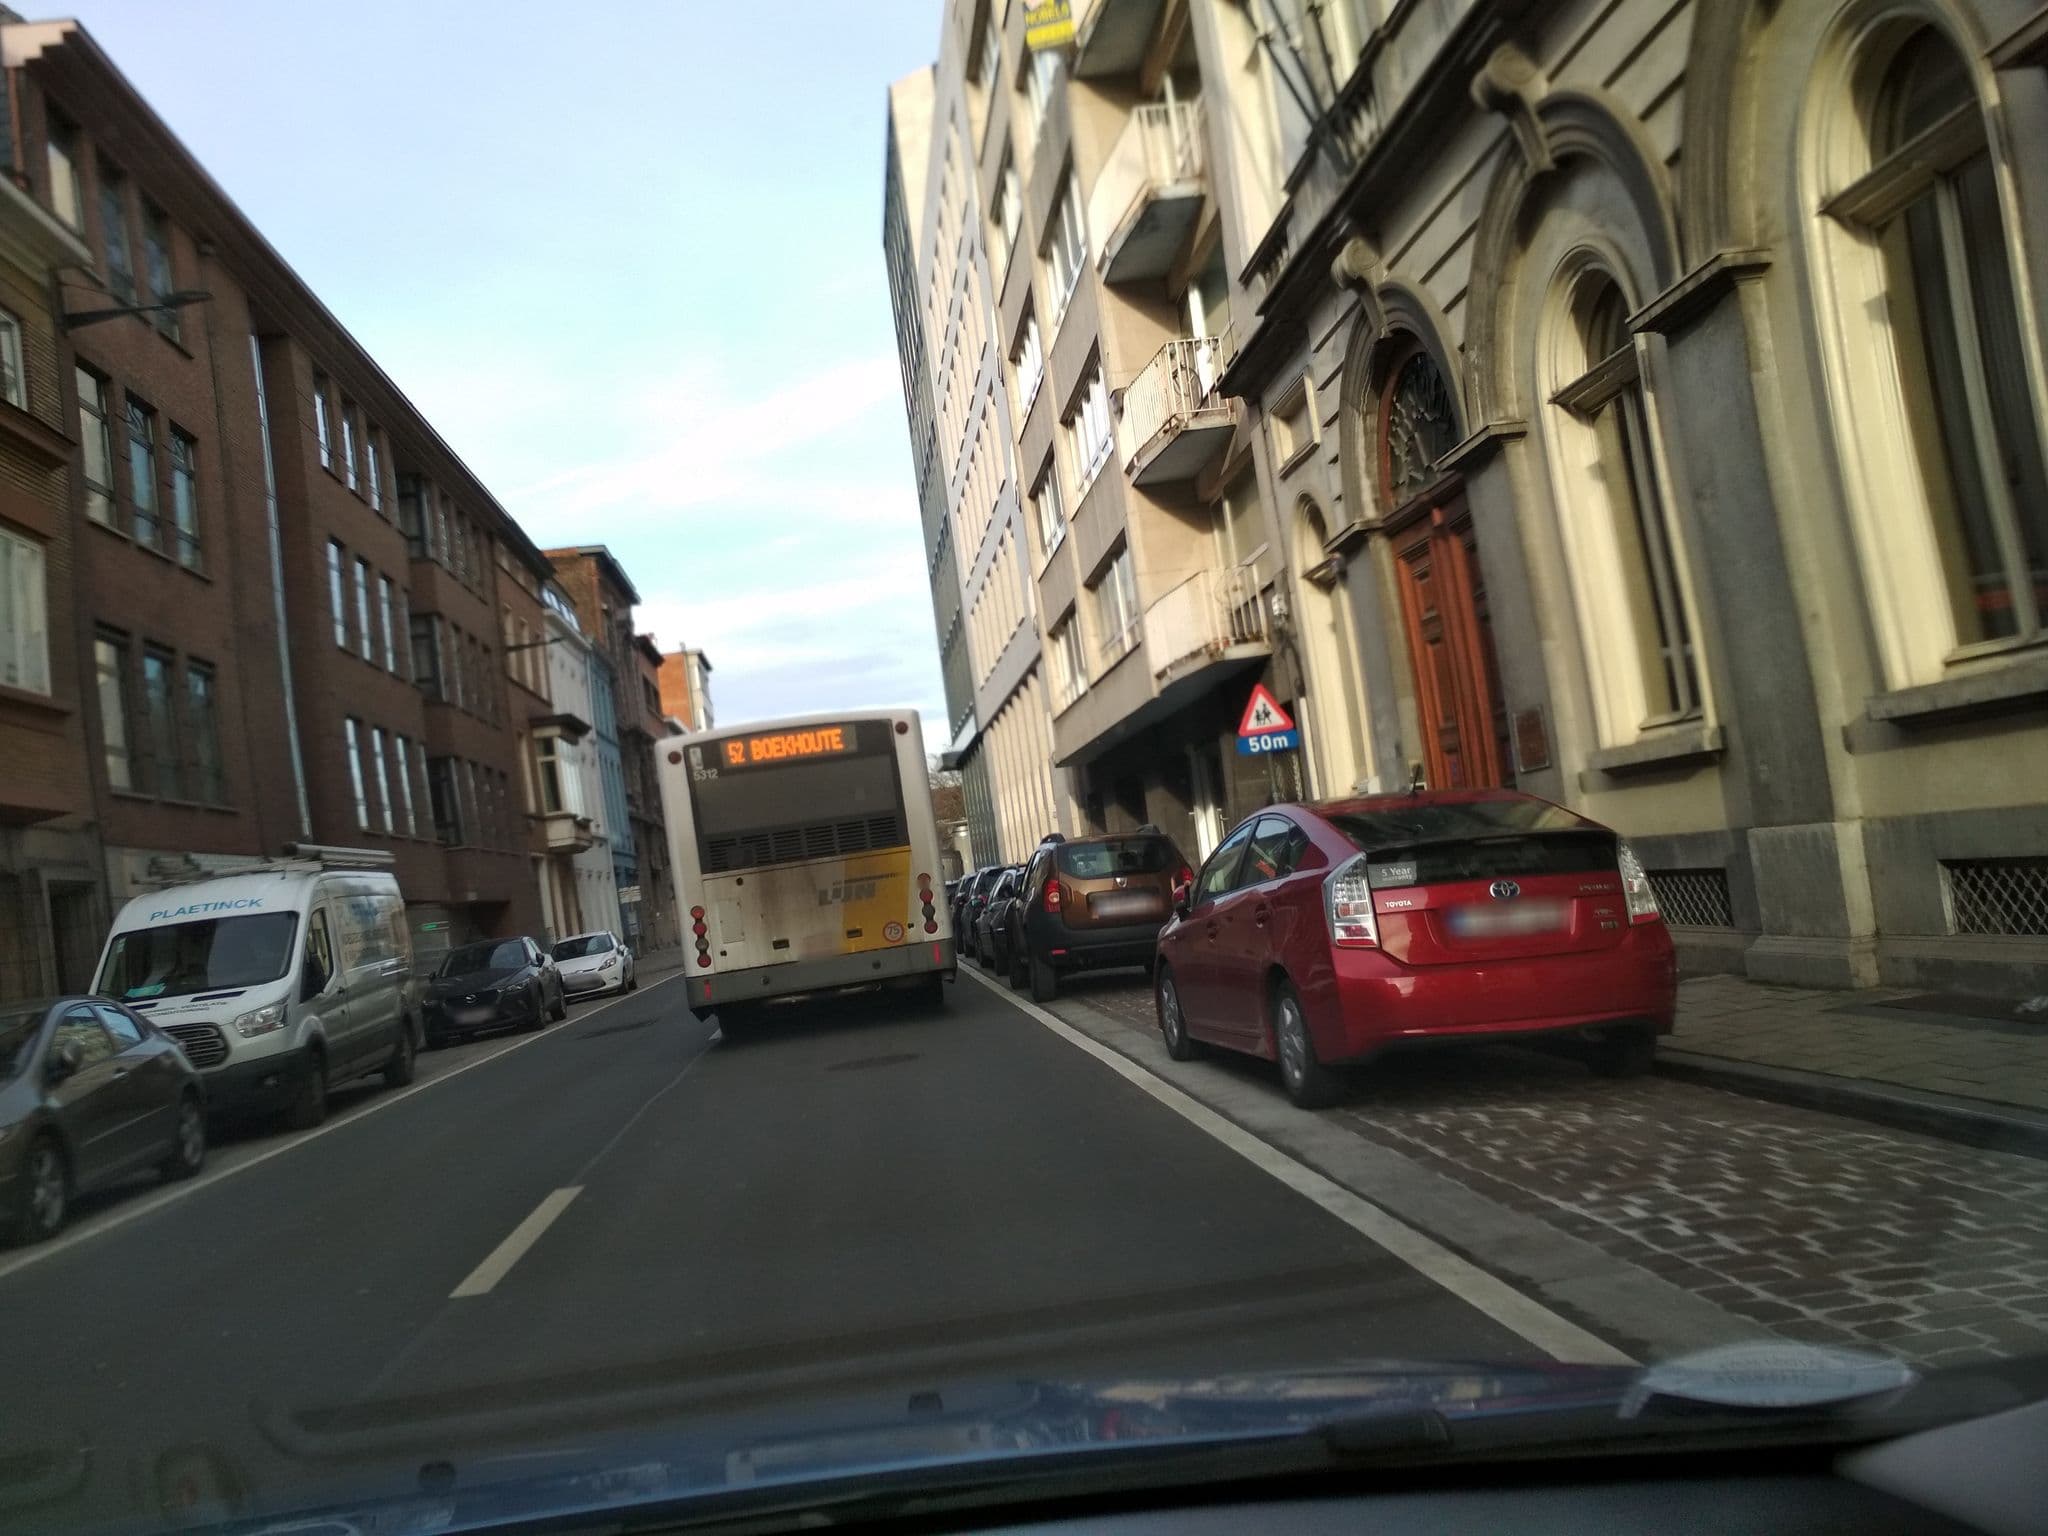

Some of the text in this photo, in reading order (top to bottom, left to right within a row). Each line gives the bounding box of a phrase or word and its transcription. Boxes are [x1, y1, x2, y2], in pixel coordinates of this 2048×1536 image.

[727, 729, 843, 763] 52 BOEKHOUTE
[1248, 735, 1289, 752] 50m
[1381, 867, 1412, 877] 5 Year
[150, 898, 264, 921] PLAETINCK
[1385, 900, 1412, 908] TOYOTA
[887, 926, 901, 936] 75
